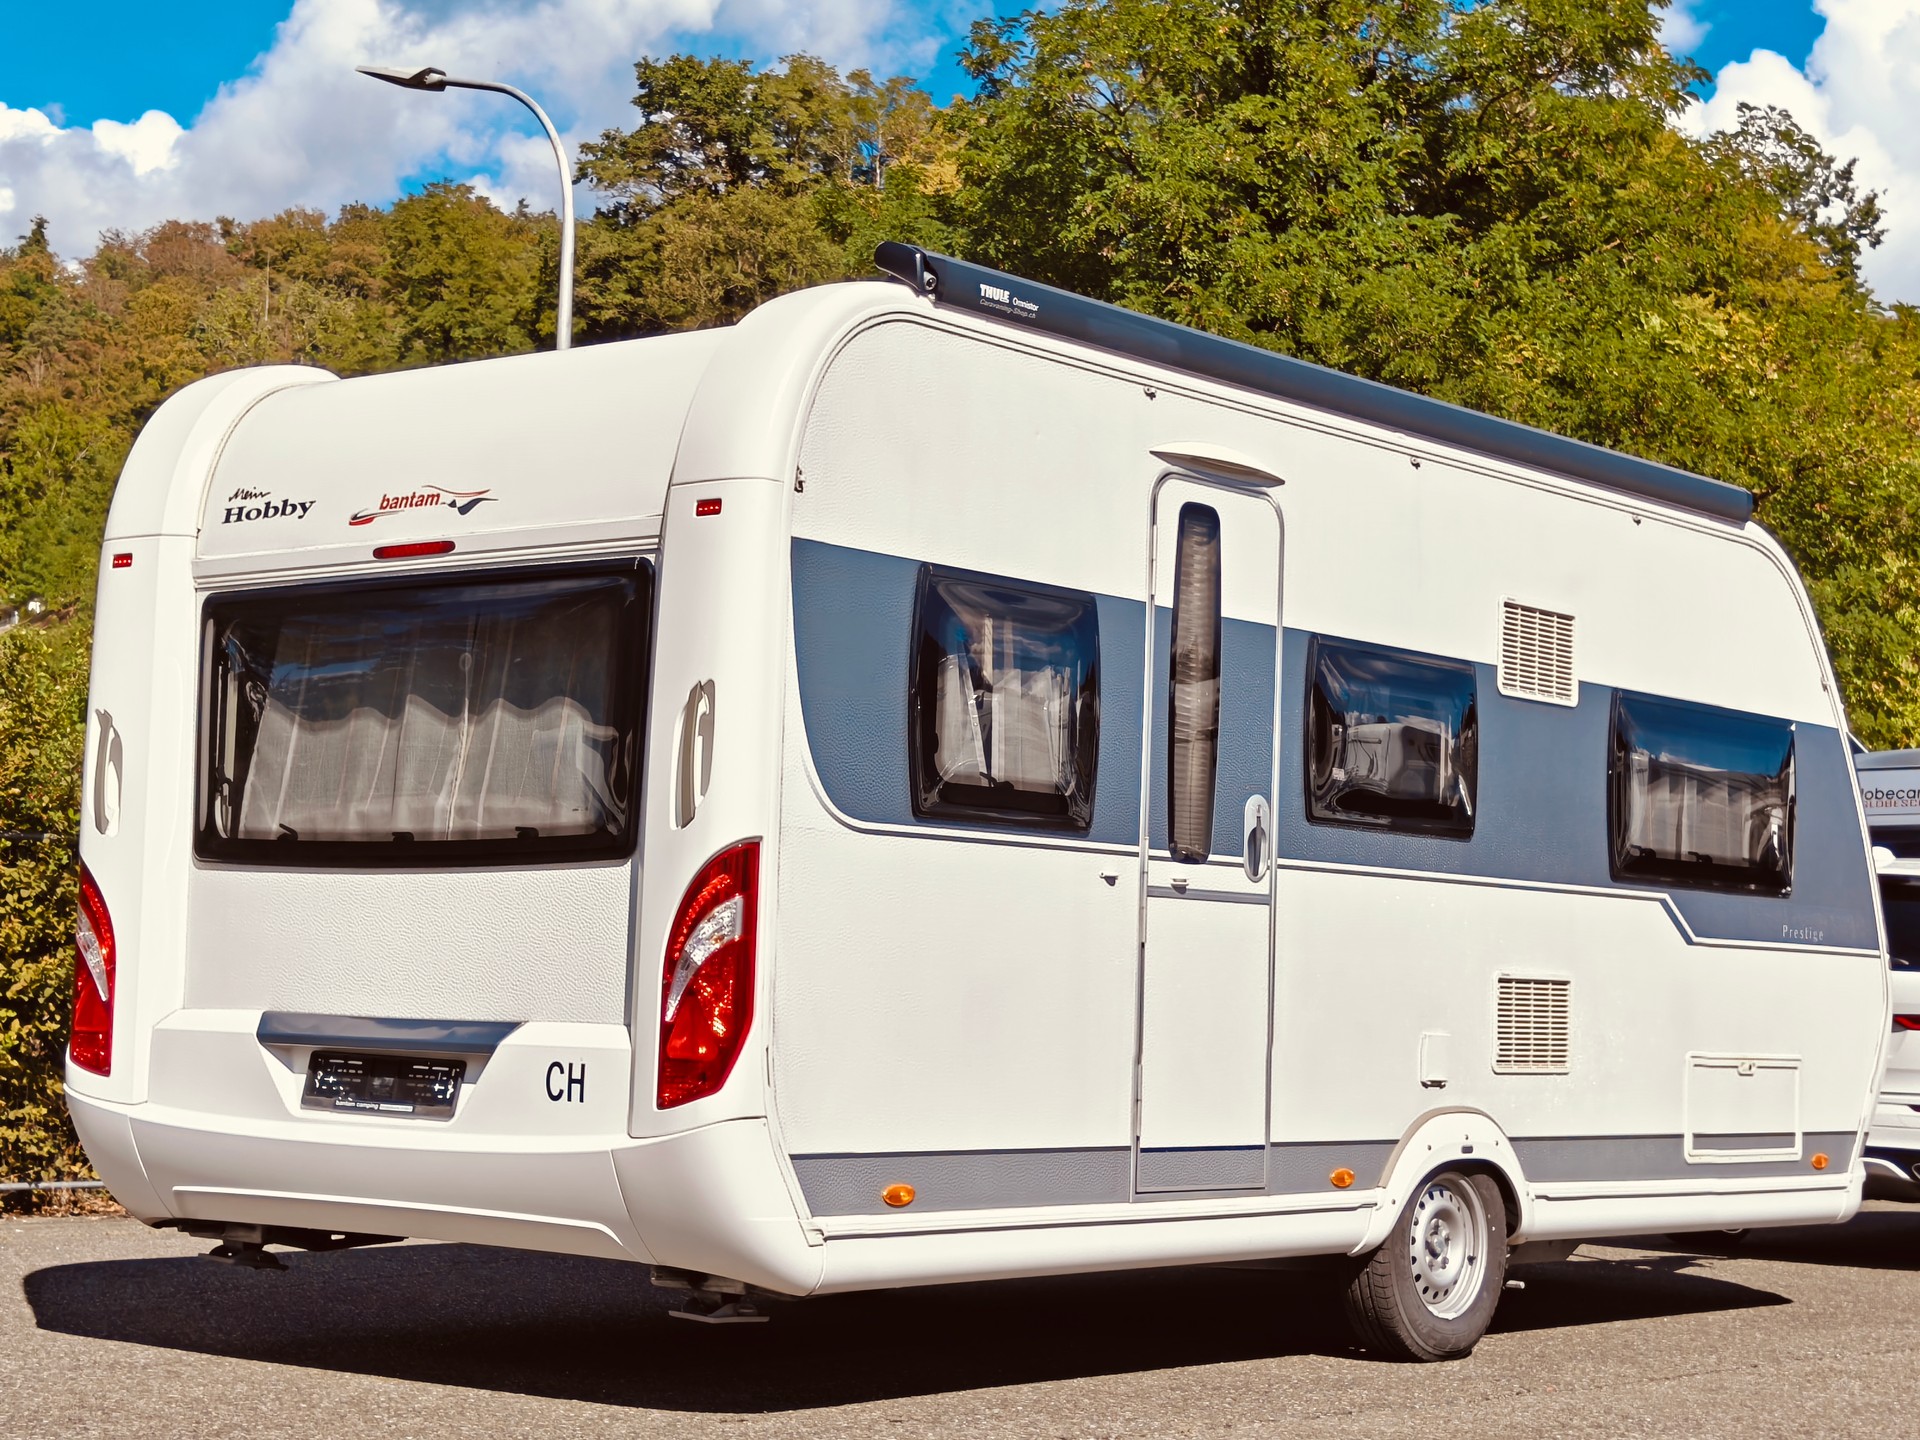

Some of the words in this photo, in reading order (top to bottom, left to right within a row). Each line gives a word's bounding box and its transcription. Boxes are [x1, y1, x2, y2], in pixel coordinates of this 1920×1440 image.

[979, 283, 1011, 304] THULE
[1012, 297, 1040, 312] Omnistor
[228, 486, 271, 502] Mein
[379, 491, 441, 510] bantam
[221, 499, 317, 524] Hobby
[1782, 924, 1825, 942] Prestige
[545, 1060, 586, 1104] CH
